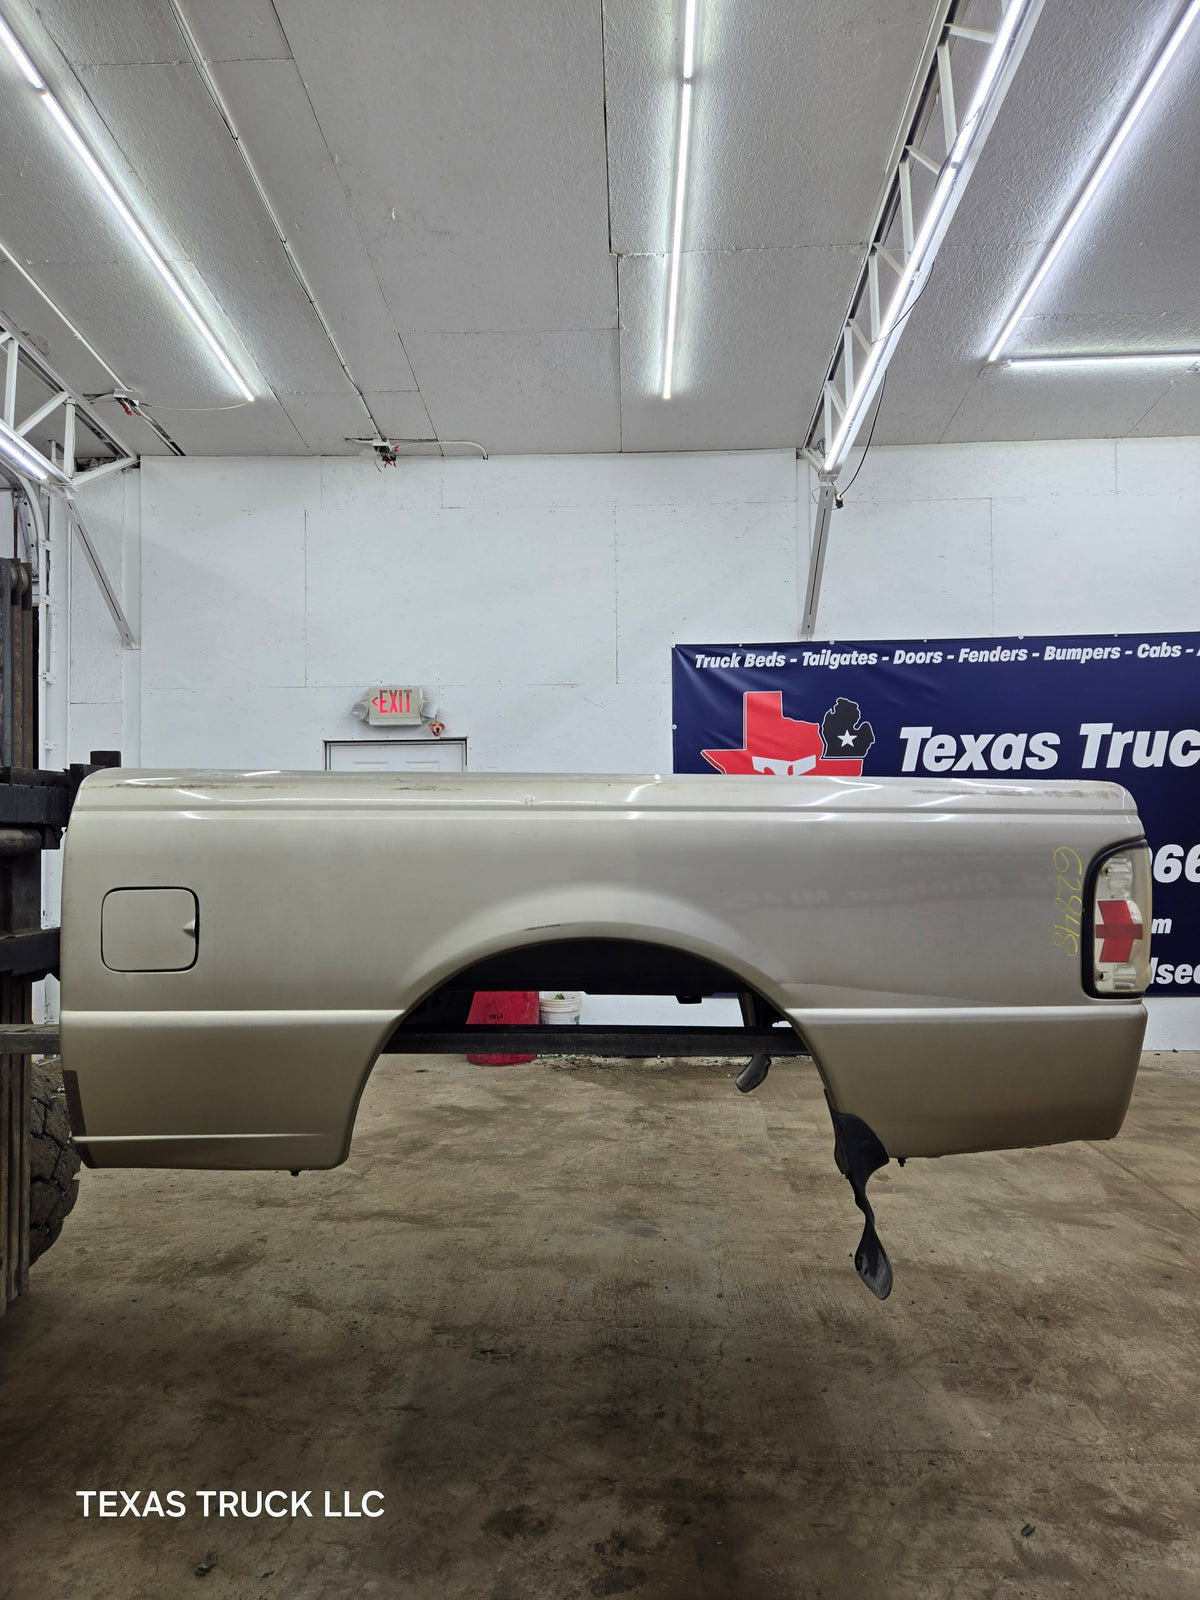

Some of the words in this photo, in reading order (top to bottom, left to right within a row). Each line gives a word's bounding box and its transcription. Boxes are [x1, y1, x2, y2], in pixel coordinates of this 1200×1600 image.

[695, 652, 742, 669] Truck
[744, 651, 786, 668] Beds
[802, 649, 878, 670] Tailgates
[893, 650, 943, 665] Doors
[958, 646, 1028, 663] Fenders
[1044, 646, 1121, 664] Bumpers
[1137, 642, 1182, 659] Cabs
[379, 690, 412, 714] EXIT
[900, 726, 1061, 773] Texas
